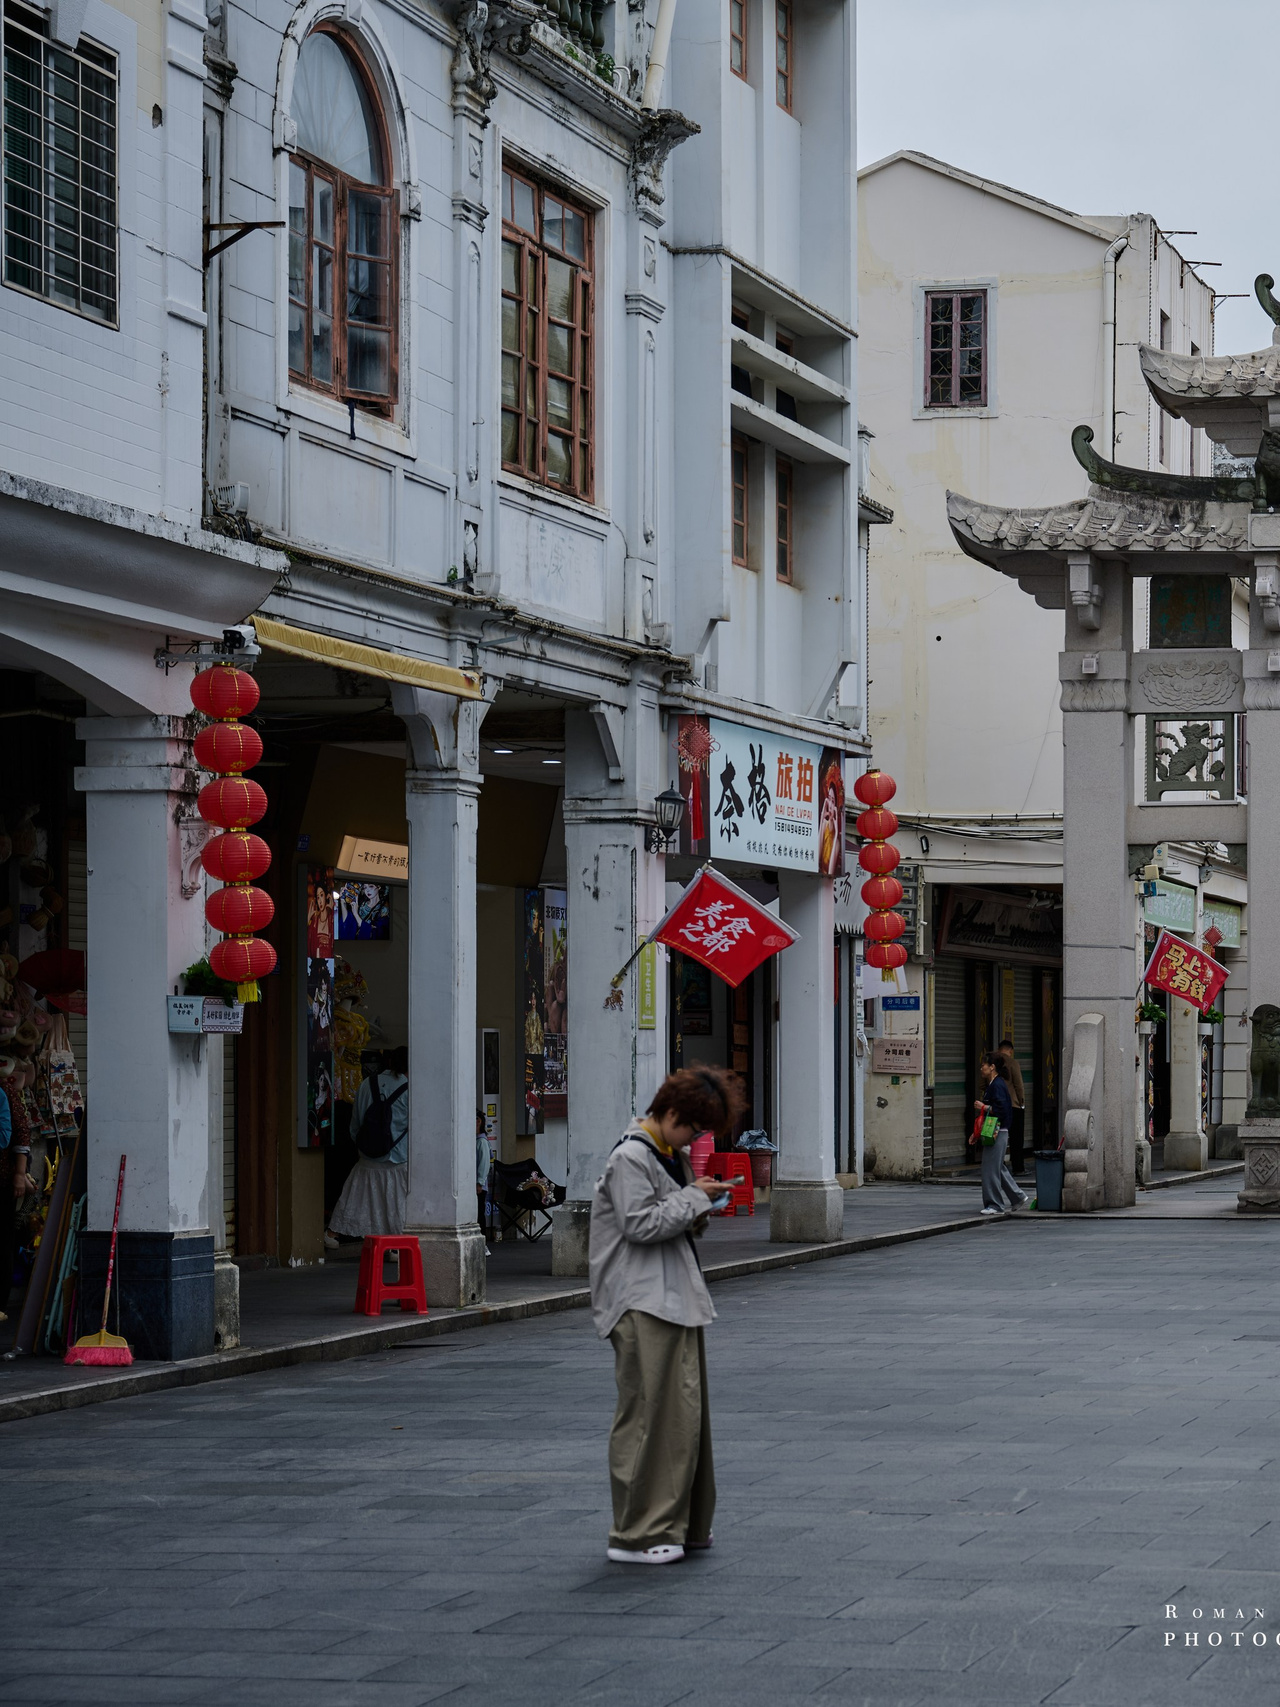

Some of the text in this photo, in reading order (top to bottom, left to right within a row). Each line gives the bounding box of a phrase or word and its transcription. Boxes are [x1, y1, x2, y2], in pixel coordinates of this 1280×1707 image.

[776, 751, 814, 803] 旅拍
[775, 804, 785, 815] NAI
[787, 806, 795, 817] GE
[1165, 943, 1202, 977] 马上
[1169, 967, 1206, 1004] 有钱
